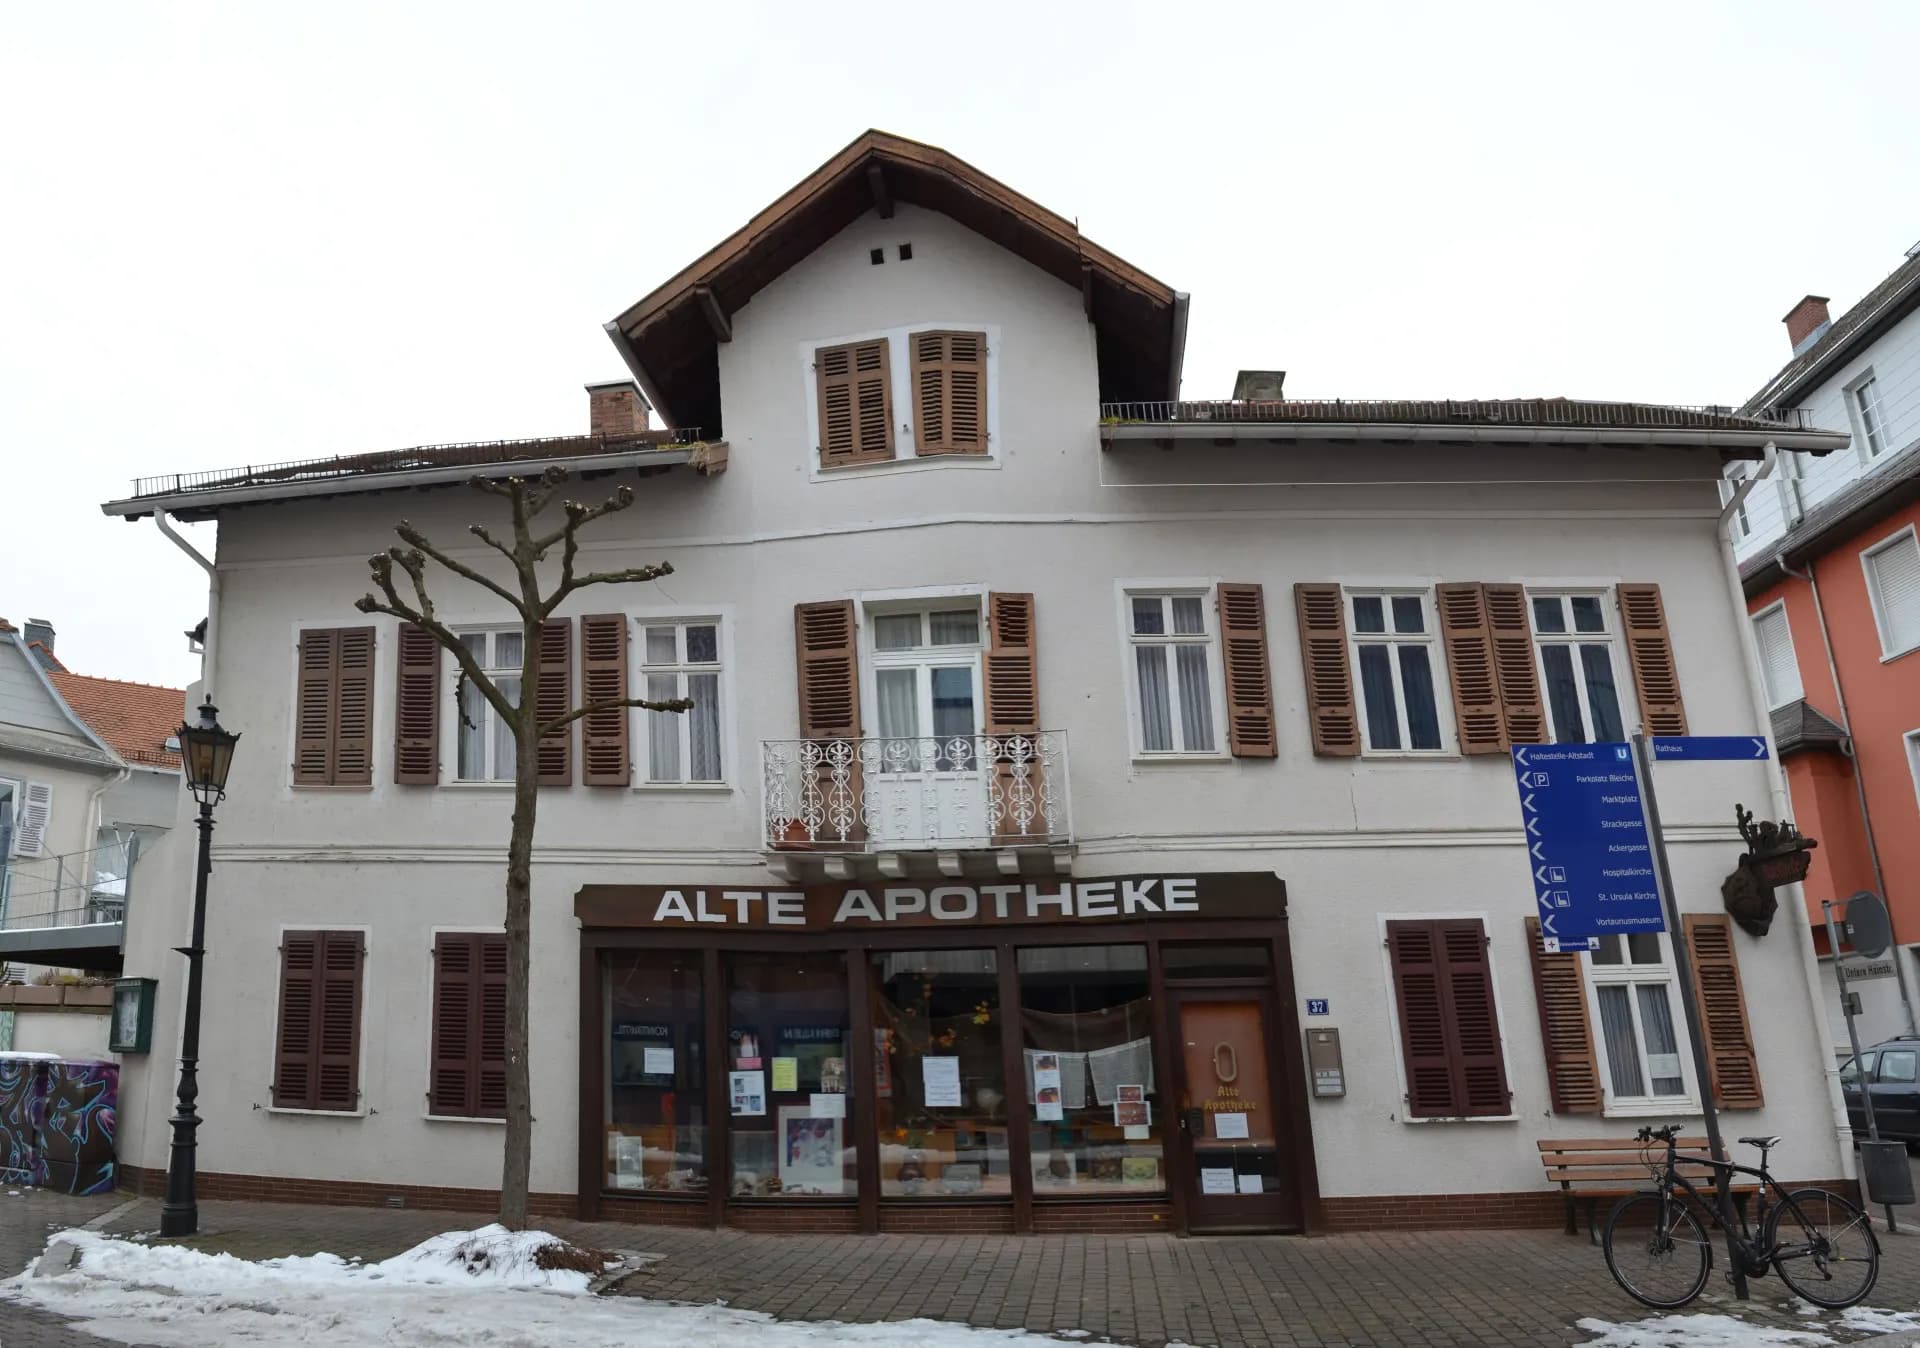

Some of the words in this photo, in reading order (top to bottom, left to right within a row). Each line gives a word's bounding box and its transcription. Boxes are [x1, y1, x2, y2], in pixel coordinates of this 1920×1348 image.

[1655, 744, 1683, 752] Rathaus
[1576, 775, 1608, 783] Parkplatz
[1609, 774, 1634, 782] Bleiche
[1602, 795, 1638, 803] Marktplatz
[1601, 820, 1643, 828] Strackgasse
[1608, 844, 1648, 853] Ackergasse
[1603, 868, 1652, 877] Hospitalkirche
[1598, 893, 1608, 901] St.
[1610, 893, 1633, 901] Ursula
[1634, 892, 1657, 900] Kirche
[653, 890, 806, 925] ALTE
[833, 878, 1199, 923] APOTHEKE
[1596, 917, 1661, 926] Vortaunusmuseum
[1311, 1001, 1323, 1013] 37
[1217, 1086, 1239, 1097] Alte
[1204, 1099, 1257, 1112] Apotheke
